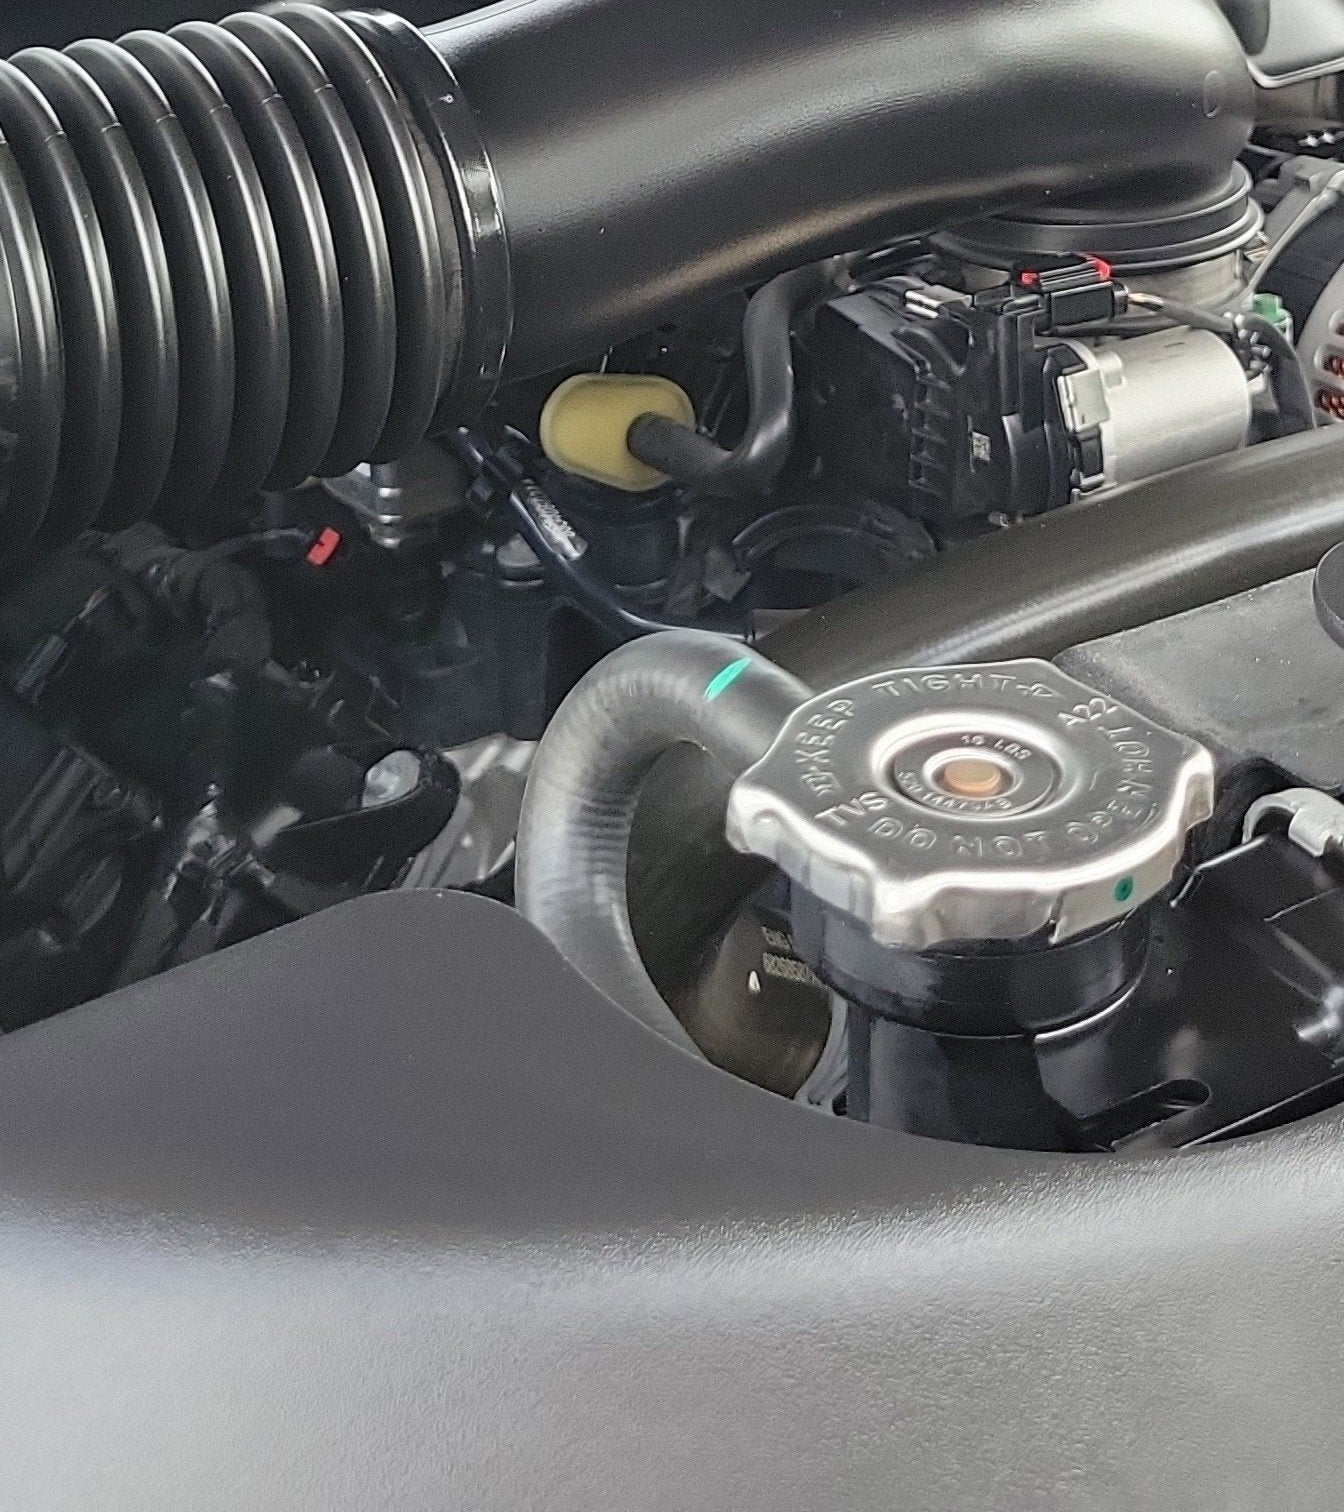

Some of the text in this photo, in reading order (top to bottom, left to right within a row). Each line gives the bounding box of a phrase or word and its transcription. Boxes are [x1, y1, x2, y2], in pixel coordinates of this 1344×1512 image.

[794, 672, 1017, 764] KEEP TIGHT
[1058, 697, 1118, 727] A22
[814, 791, 888, 826] TVS
[868, 816, 938, 849] DO
[953, 830, 1049, 857] NOT
[1097, 726, 1154, 774] HOT
